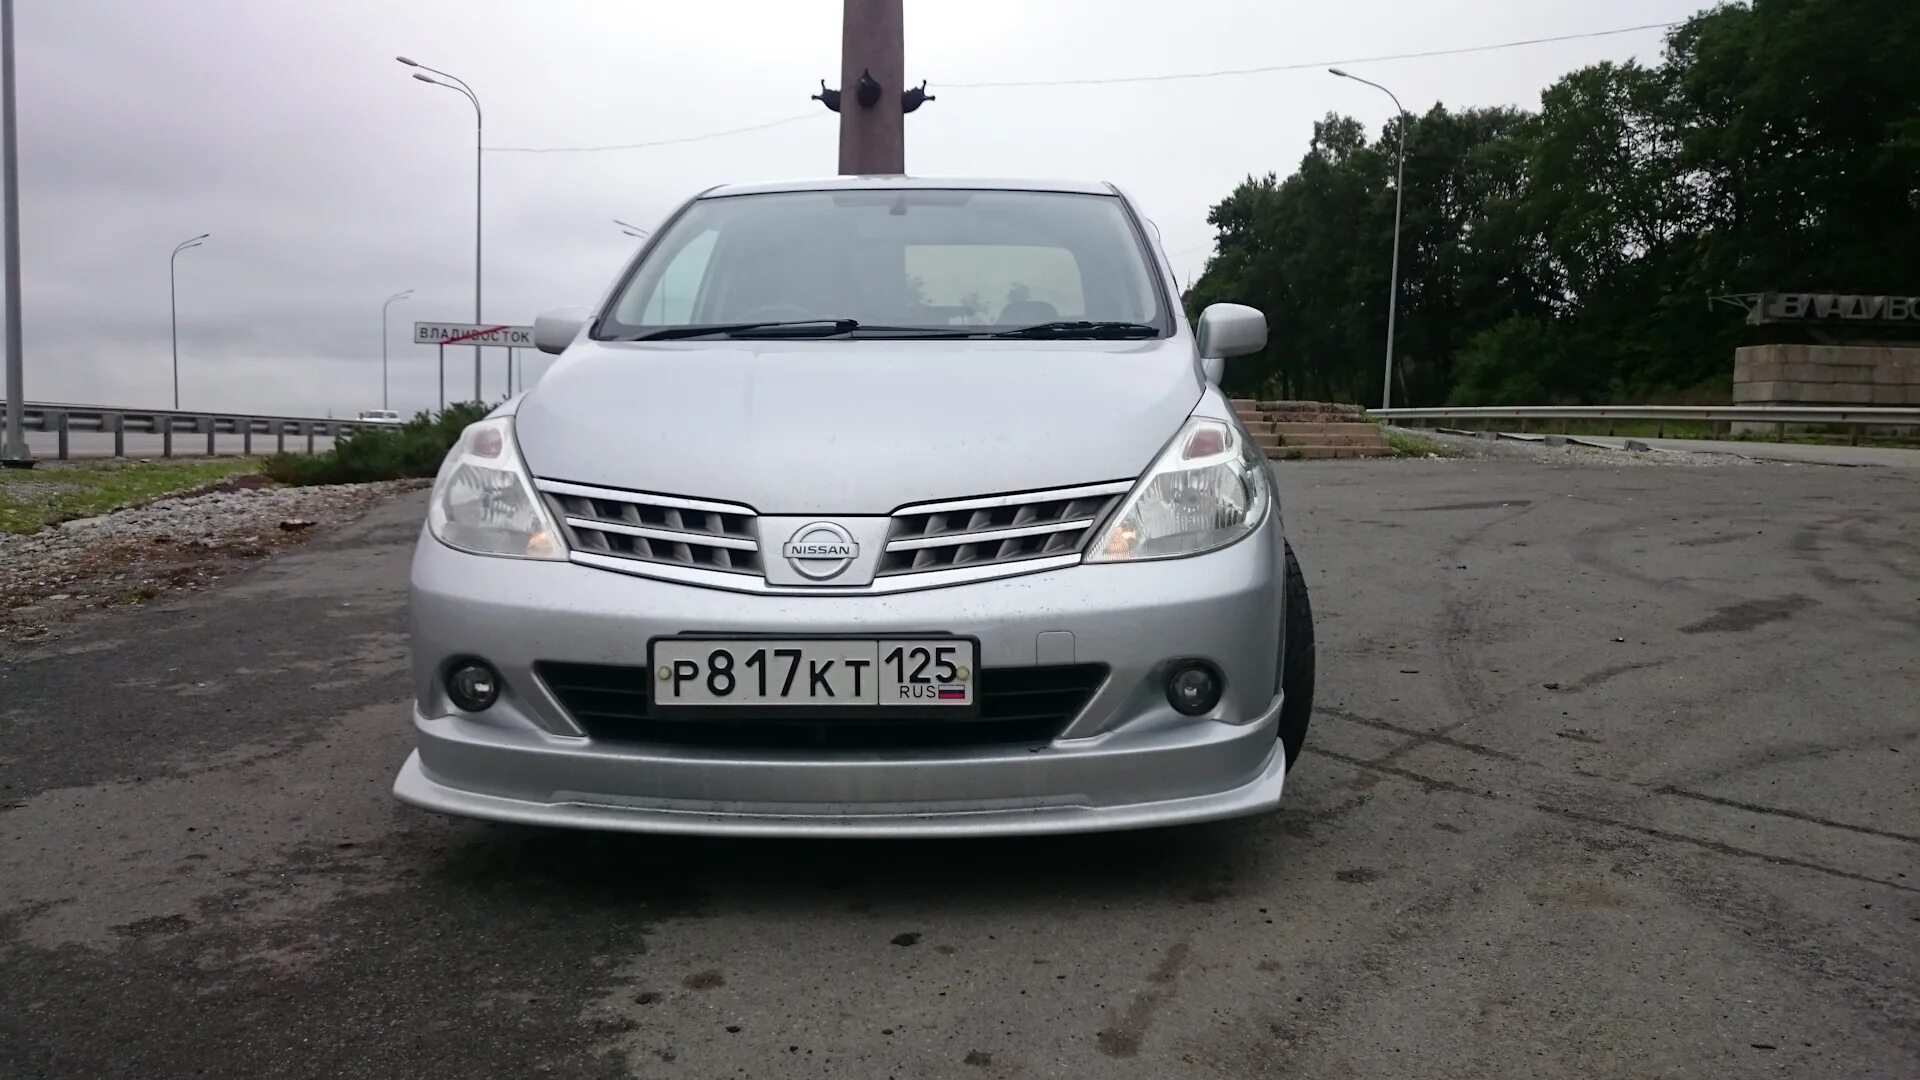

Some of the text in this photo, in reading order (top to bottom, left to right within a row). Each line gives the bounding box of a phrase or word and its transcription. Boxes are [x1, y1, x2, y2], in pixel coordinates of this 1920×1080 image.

[420, 327, 530, 343] ВЛАДИВОСТОК
[791, 545, 850, 555] NISSAN
[884, 647, 958, 684] 125
[899, 685, 937, 699] RUS
